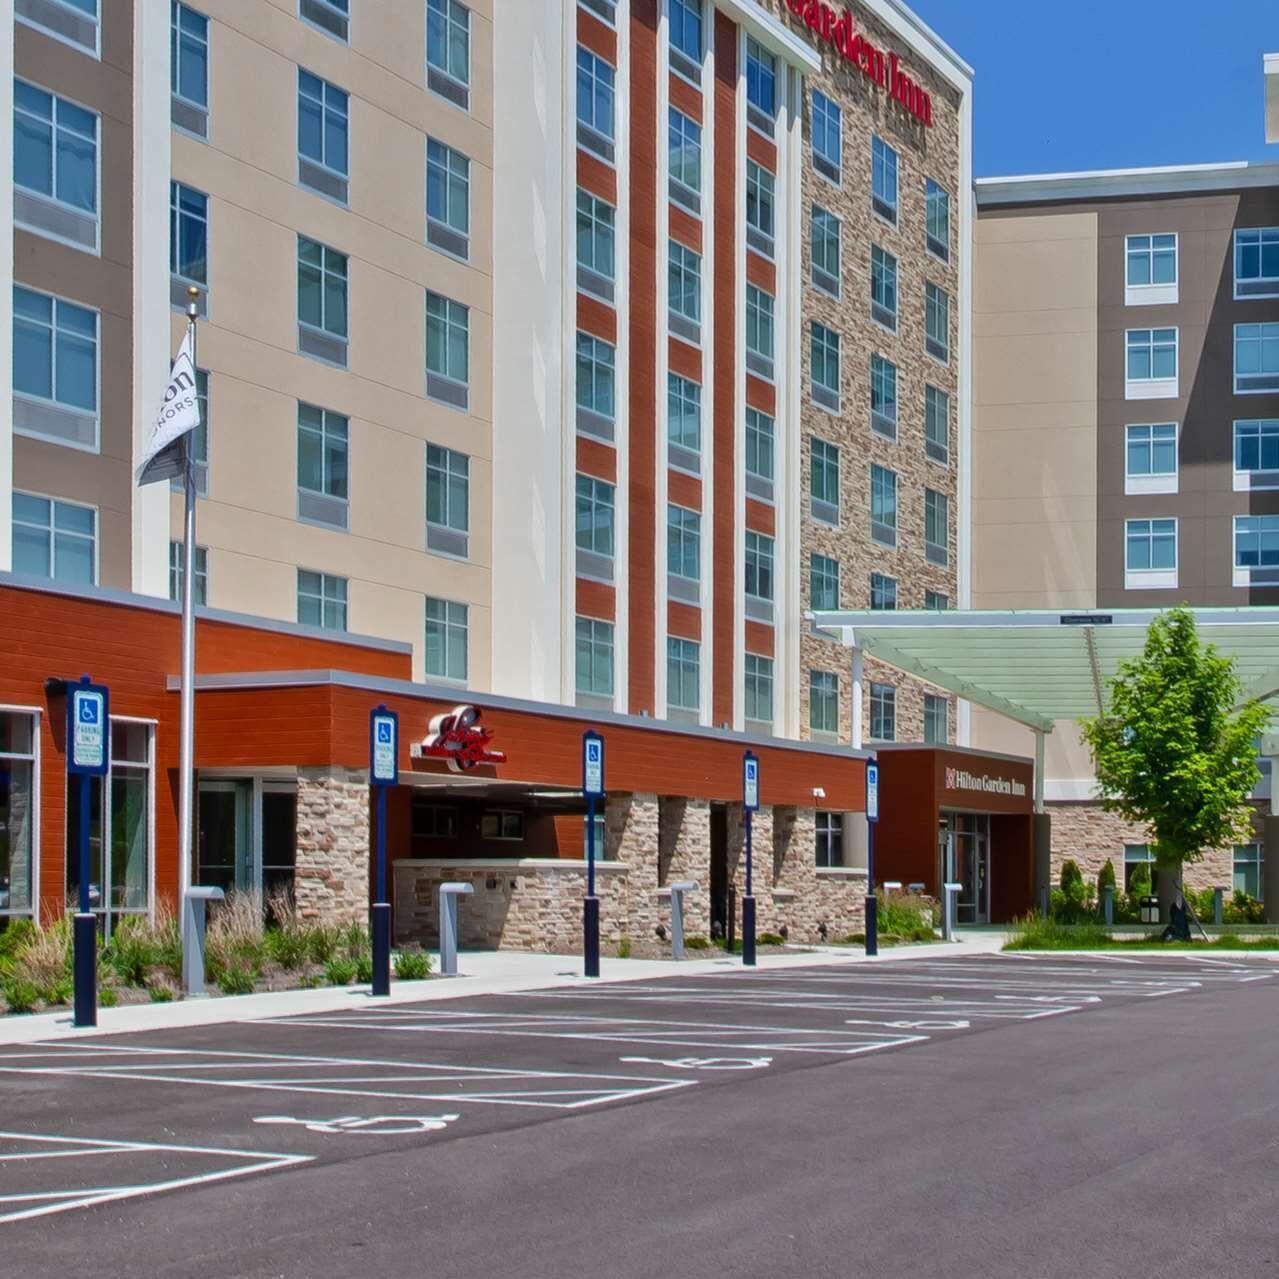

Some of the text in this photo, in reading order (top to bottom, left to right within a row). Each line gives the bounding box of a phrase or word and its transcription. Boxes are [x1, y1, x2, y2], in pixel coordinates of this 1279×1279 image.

[888, 52, 933, 129] Inn
[956, 770, 1026, 797] Hilton Garden Inn
